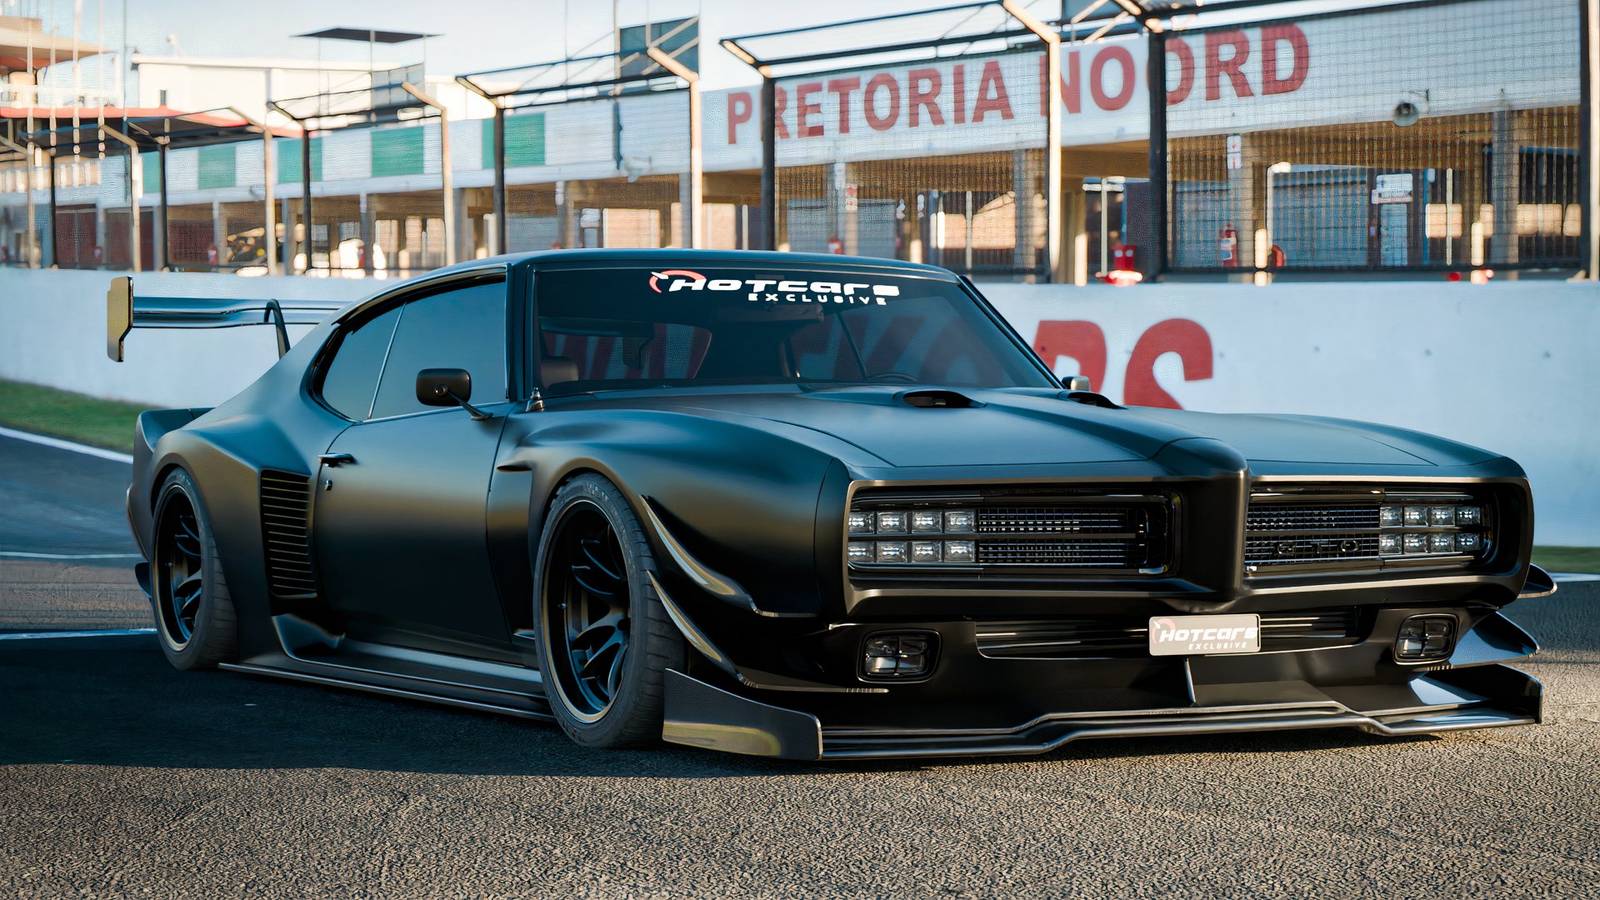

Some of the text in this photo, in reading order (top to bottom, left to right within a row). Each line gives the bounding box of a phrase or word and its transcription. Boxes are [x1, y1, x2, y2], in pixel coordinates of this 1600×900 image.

[727, 23, 1311, 145] PRETORIA NOORD
[748, 293, 888, 306] EXCLUSIVE
